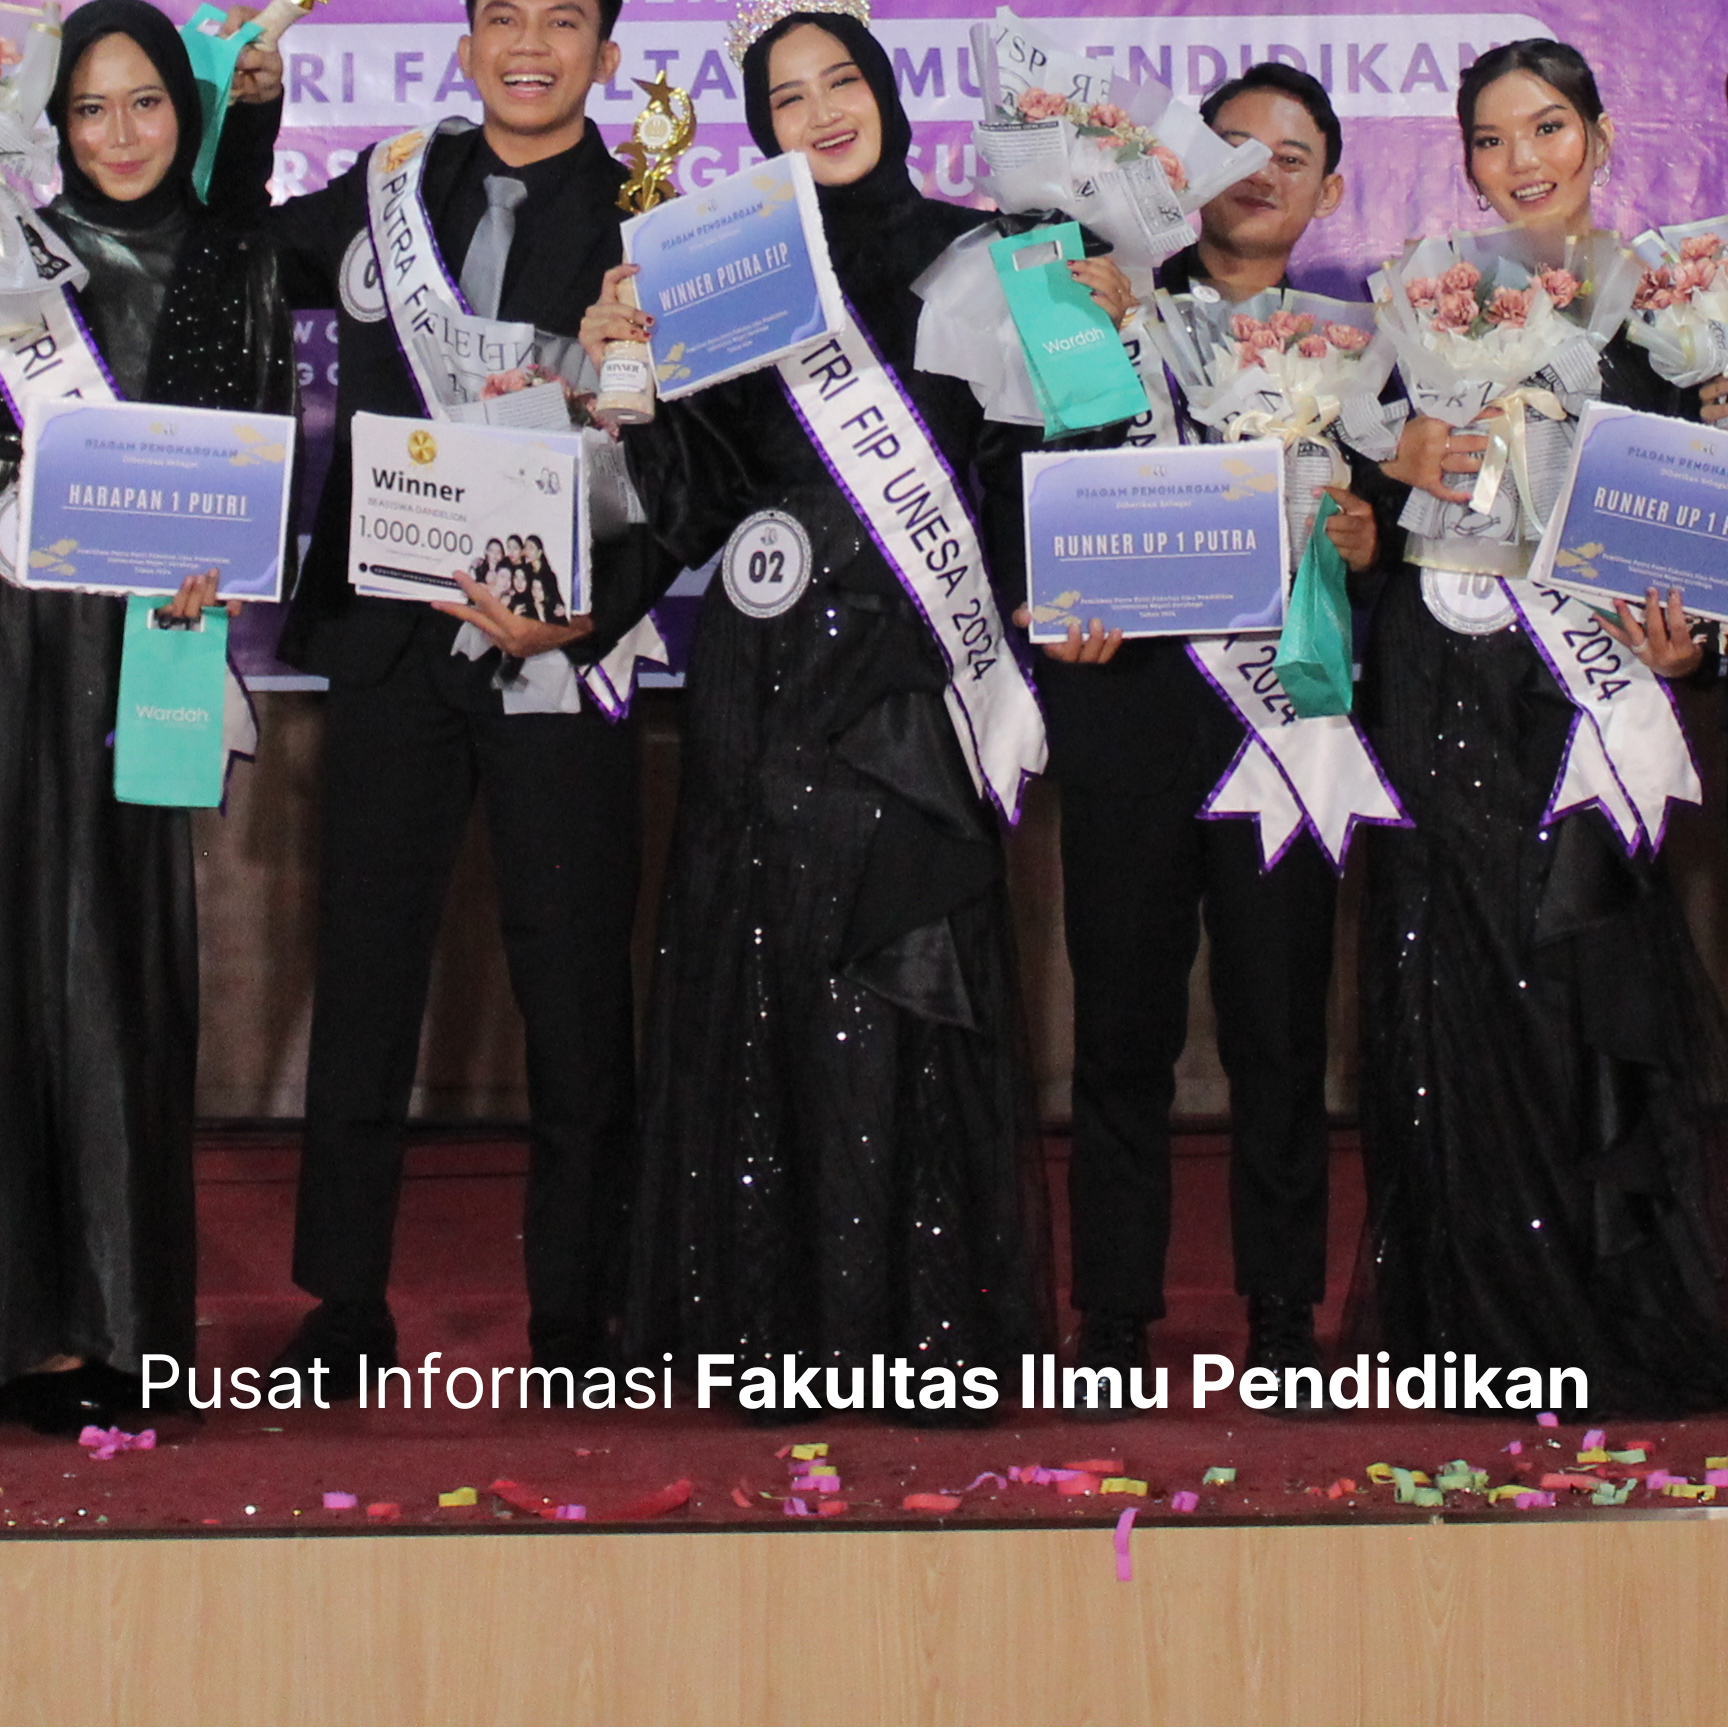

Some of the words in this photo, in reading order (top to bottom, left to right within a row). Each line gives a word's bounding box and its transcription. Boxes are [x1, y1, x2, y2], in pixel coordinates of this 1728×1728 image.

[393, 48, 739, 104] FALTA
[381, 172, 417, 287] PUTRA
[659, 271, 714, 311] WINNER
[716, 254, 763, 288] PUTRA
[765, 241, 789, 269] FIP
[1042, 325, 1106, 356] Wardah
[68, 483, 163, 511] HARAPAN
[171, 490, 180, 512] 1
[188, 492, 247, 517] PUTRI
[371, 467, 466, 503] Winner
[800, 338, 860, 402] TRI
[840, 404, 901, 462] FIP
[882, 466, 970, 599] UNESA
[952, 598, 999, 682] 2024
[1593, 486, 1670, 522] RUNNER
[1675, 505, 1702, 528] UP
[1707, 511, 1717, 533] 1
[358, 514, 473, 556] 1.000.000
[1054, 532, 1134, 557] RUNNER
[1143, 531, 1169, 554] UP
[1176, 531, 1185, 552] 1
[1194, 528, 1257, 552] PUTRA
[748, 550, 785, 584] 02
[1562, 617, 1631, 704] 2024
[136, 704, 209, 723] Wardah
